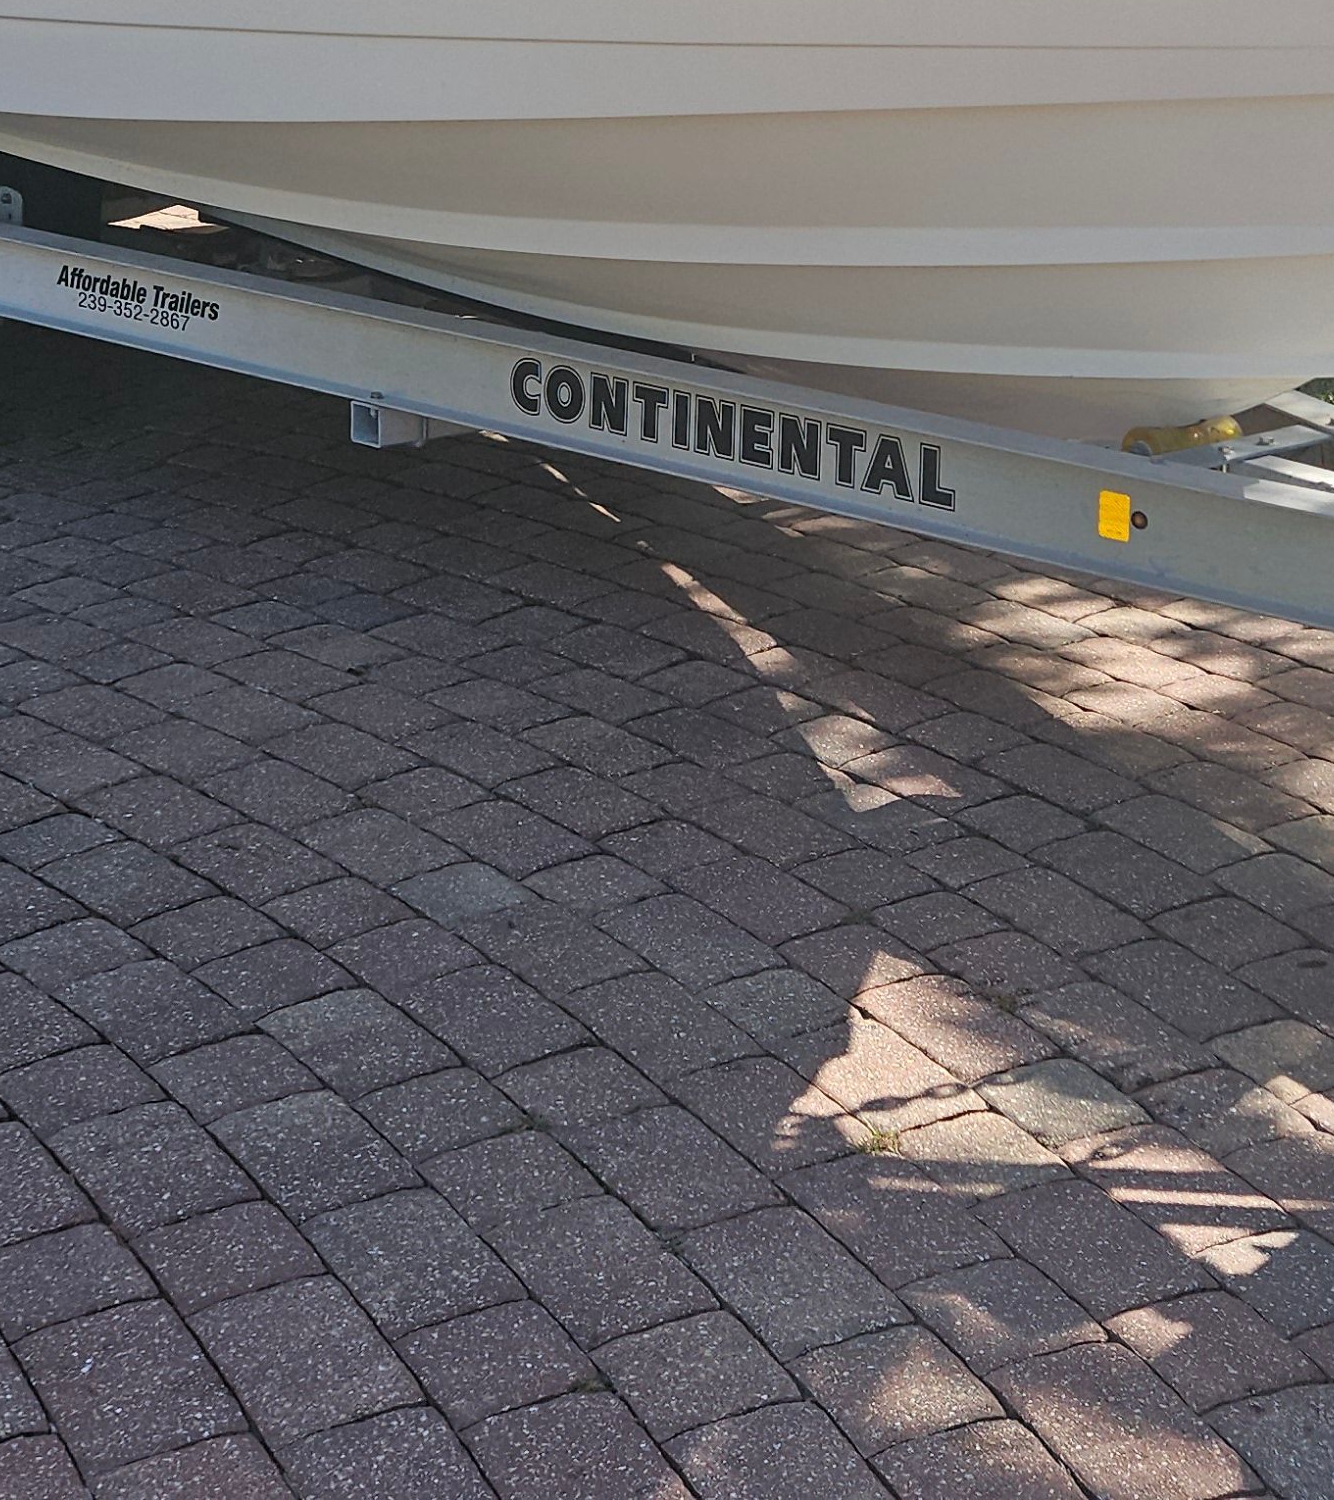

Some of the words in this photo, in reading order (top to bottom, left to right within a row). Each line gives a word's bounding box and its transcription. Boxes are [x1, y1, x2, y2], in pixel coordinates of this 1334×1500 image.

[56, 265, 147, 305] Affordable
[153, 285, 220, 321] Trailers
[78, 292, 191, 331] 239-352-2867
[509, 356, 956, 512] CONTINENTAL
